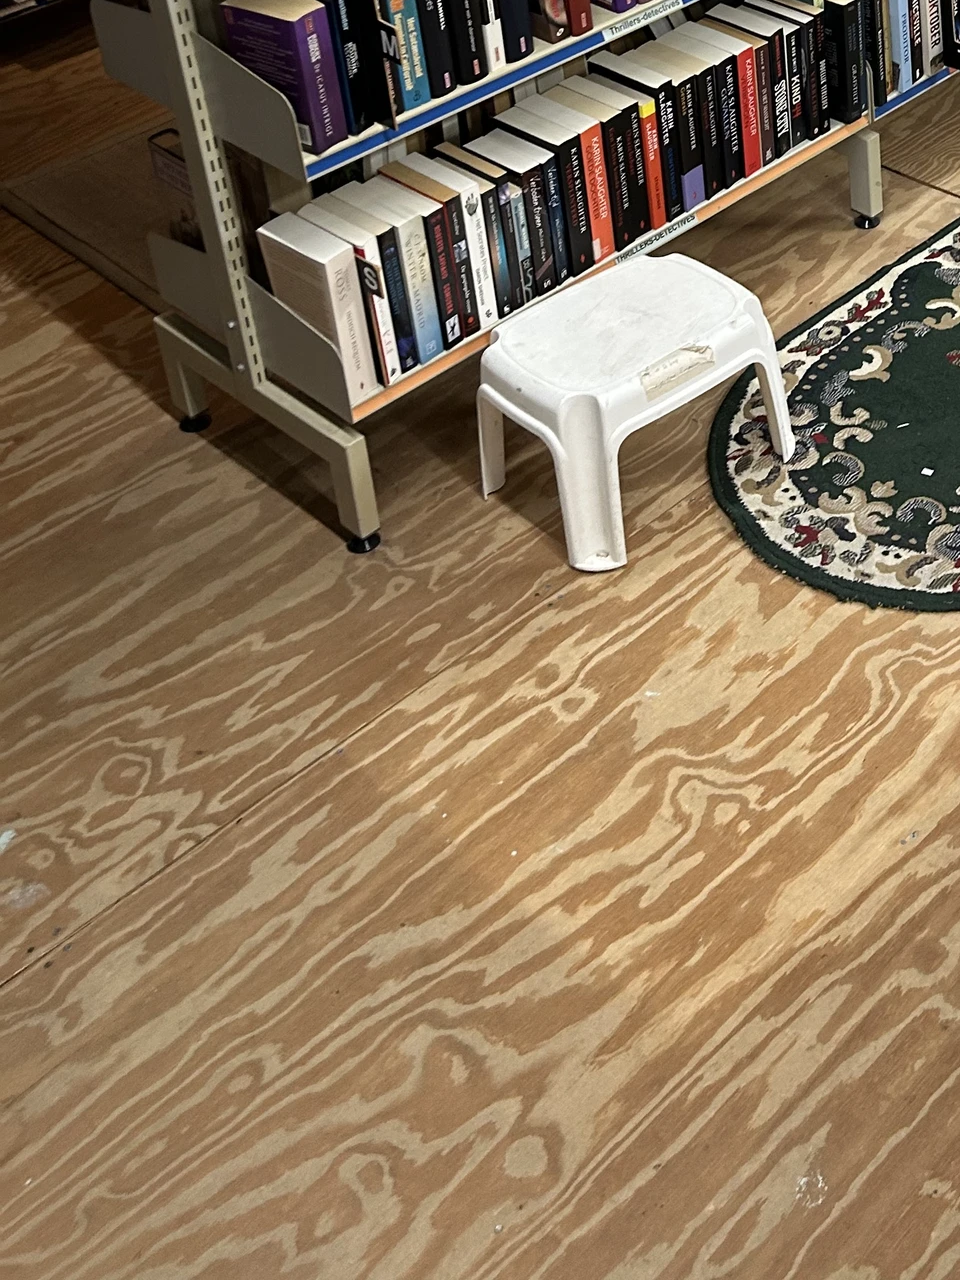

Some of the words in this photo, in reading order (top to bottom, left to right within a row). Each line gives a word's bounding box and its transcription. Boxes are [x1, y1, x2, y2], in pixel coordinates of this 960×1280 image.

[380, 30, 399, 59] M
[774, 80, 787, 114] STONE
[659, 92, 669, 146] SLAUGHTER
[666, 100, 674, 129] KARIN
[778, 114, 789, 138] CITY
[570, 147, 579, 177] KARIN
[575, 180, 587, 234] SLAUGHTER
[591, 136, 601, 165] KARIN
[596, 167, 608, 220] SLAUGHTER
[615, 214, 696, 263] THRILLERS-DETECTIVES
[334, 269, 344, 303] ROSS
[363, 267, 378, 290] S
